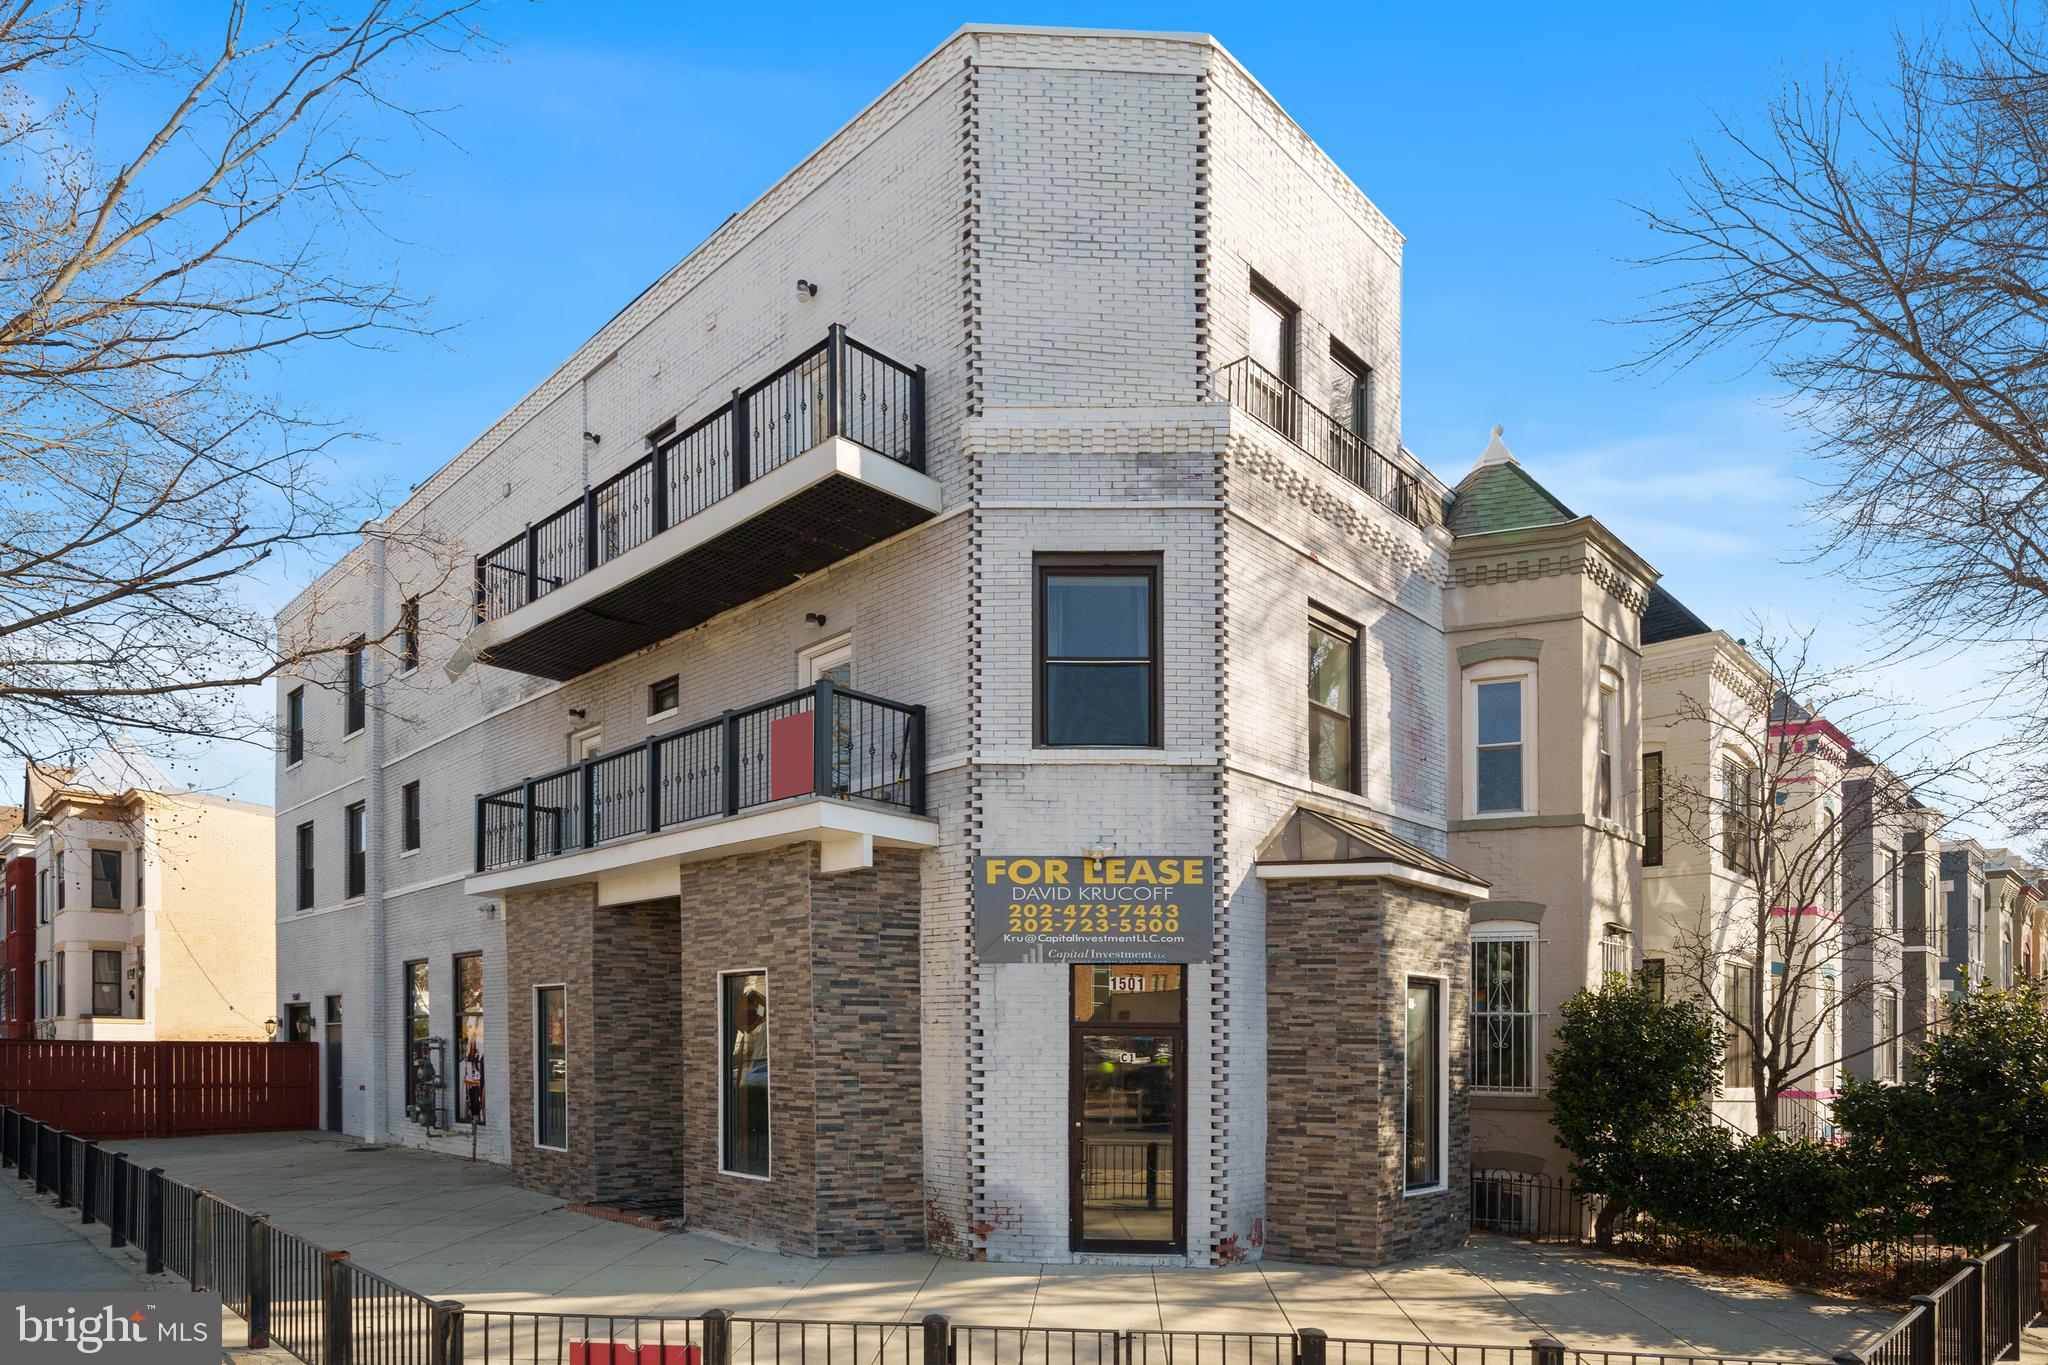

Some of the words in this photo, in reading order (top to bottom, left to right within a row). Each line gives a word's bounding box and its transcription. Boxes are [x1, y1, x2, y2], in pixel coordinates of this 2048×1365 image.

[986, 859, 1070, 885] FOR
[1083, 859, 1204, 885] LEASE
[1012, 886, 1072, 900] DAVID
[1079, 886, 1174, 900] KRUCOFF
[1008, 904, 1180, 918] 202-473-7443
[1008, 918, 1180, 933] 202-723-5500
[1003, 933, 1185, 944] Kru@CapitalInvestmentLLC.com
[1048, 949, 1089, 962] Capital
[1091, 949, 1152, 959] Investment
[1110, 977, 1145, 991] 1501
[1121, 1053, 1135, 1062] C1
